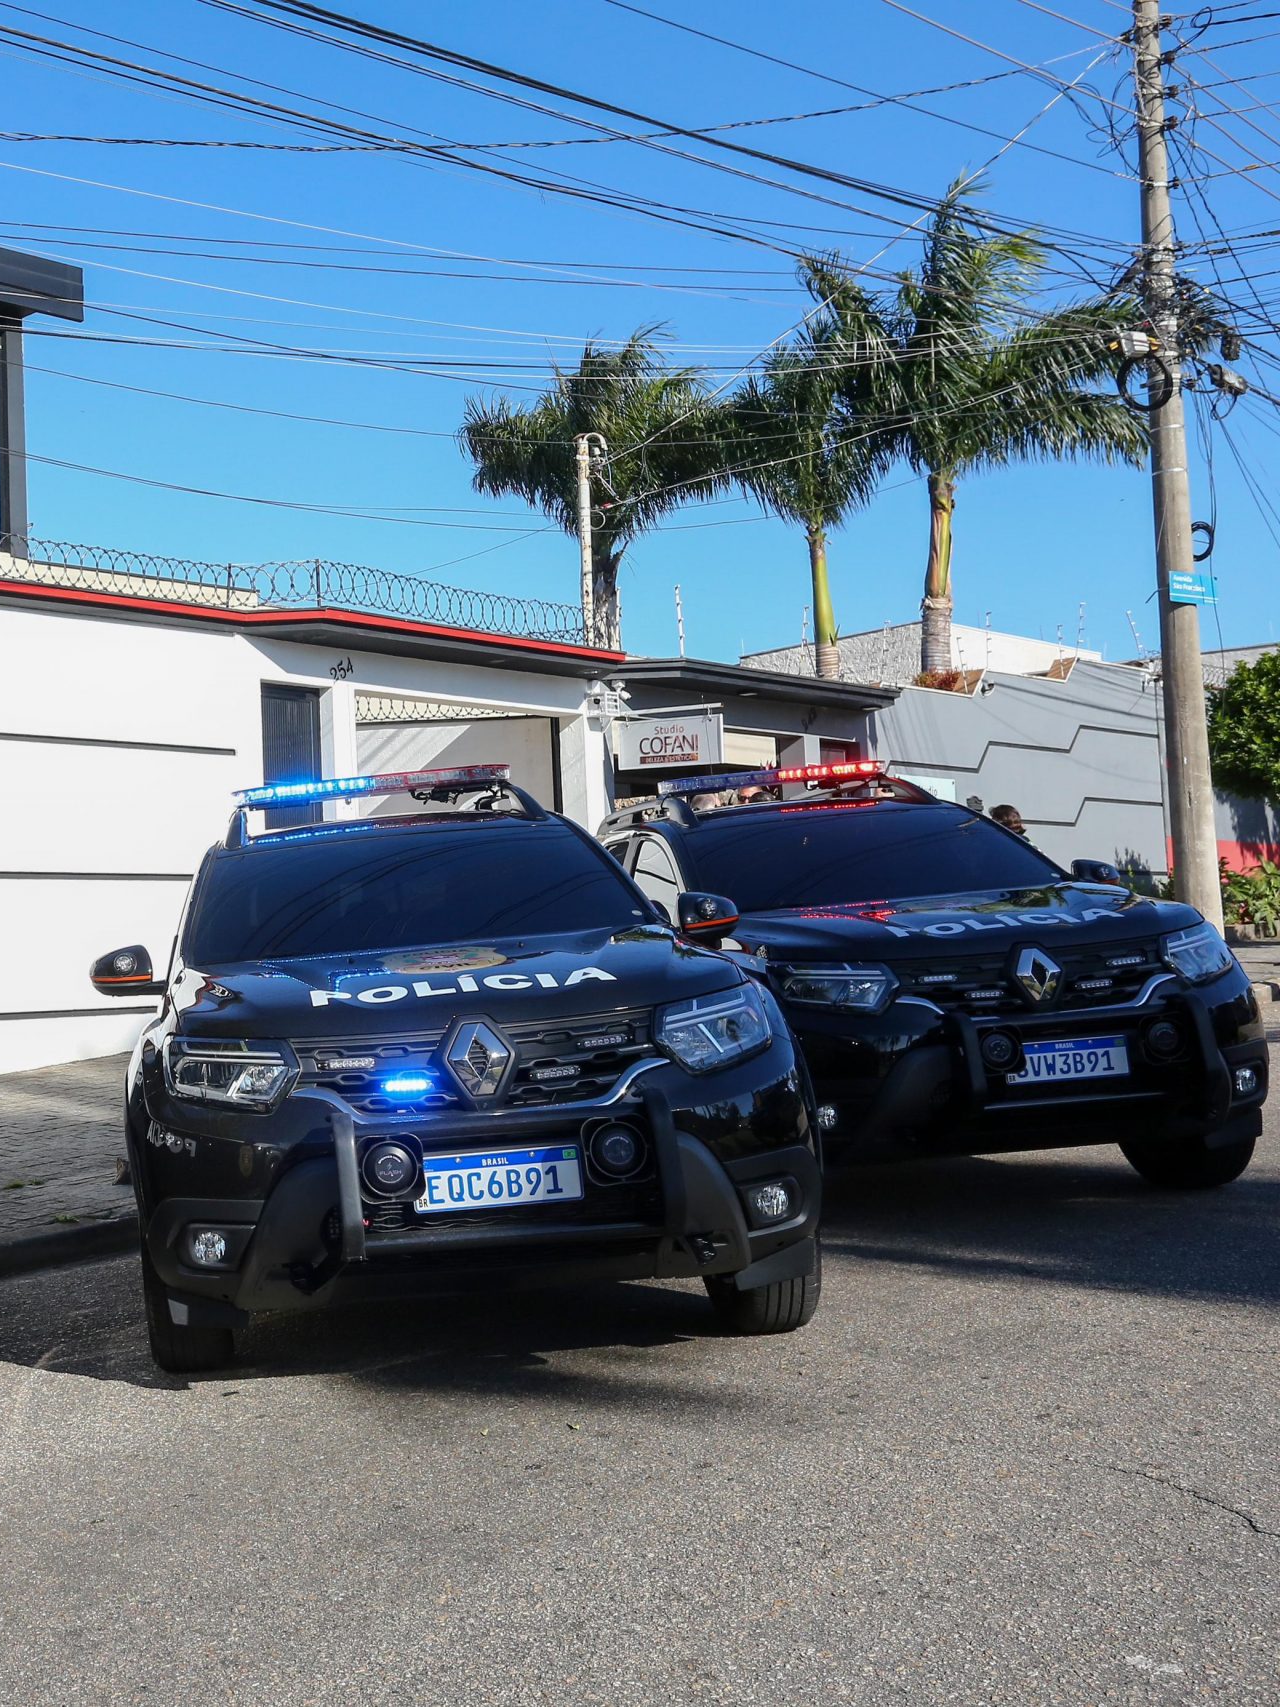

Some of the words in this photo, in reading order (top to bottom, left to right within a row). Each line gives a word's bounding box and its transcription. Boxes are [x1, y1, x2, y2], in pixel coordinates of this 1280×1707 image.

[654, 724, 685, 735] Studio
[640, 734, 698, 755] COFANI
[311, 966, 618, 1007] POLÍCIA
[1055, 1042, 1075, 1050] BRASIL
[482, 1157, 509, 1166] BRASIL
[427, 1165, 564, 1205] EQC6B91
